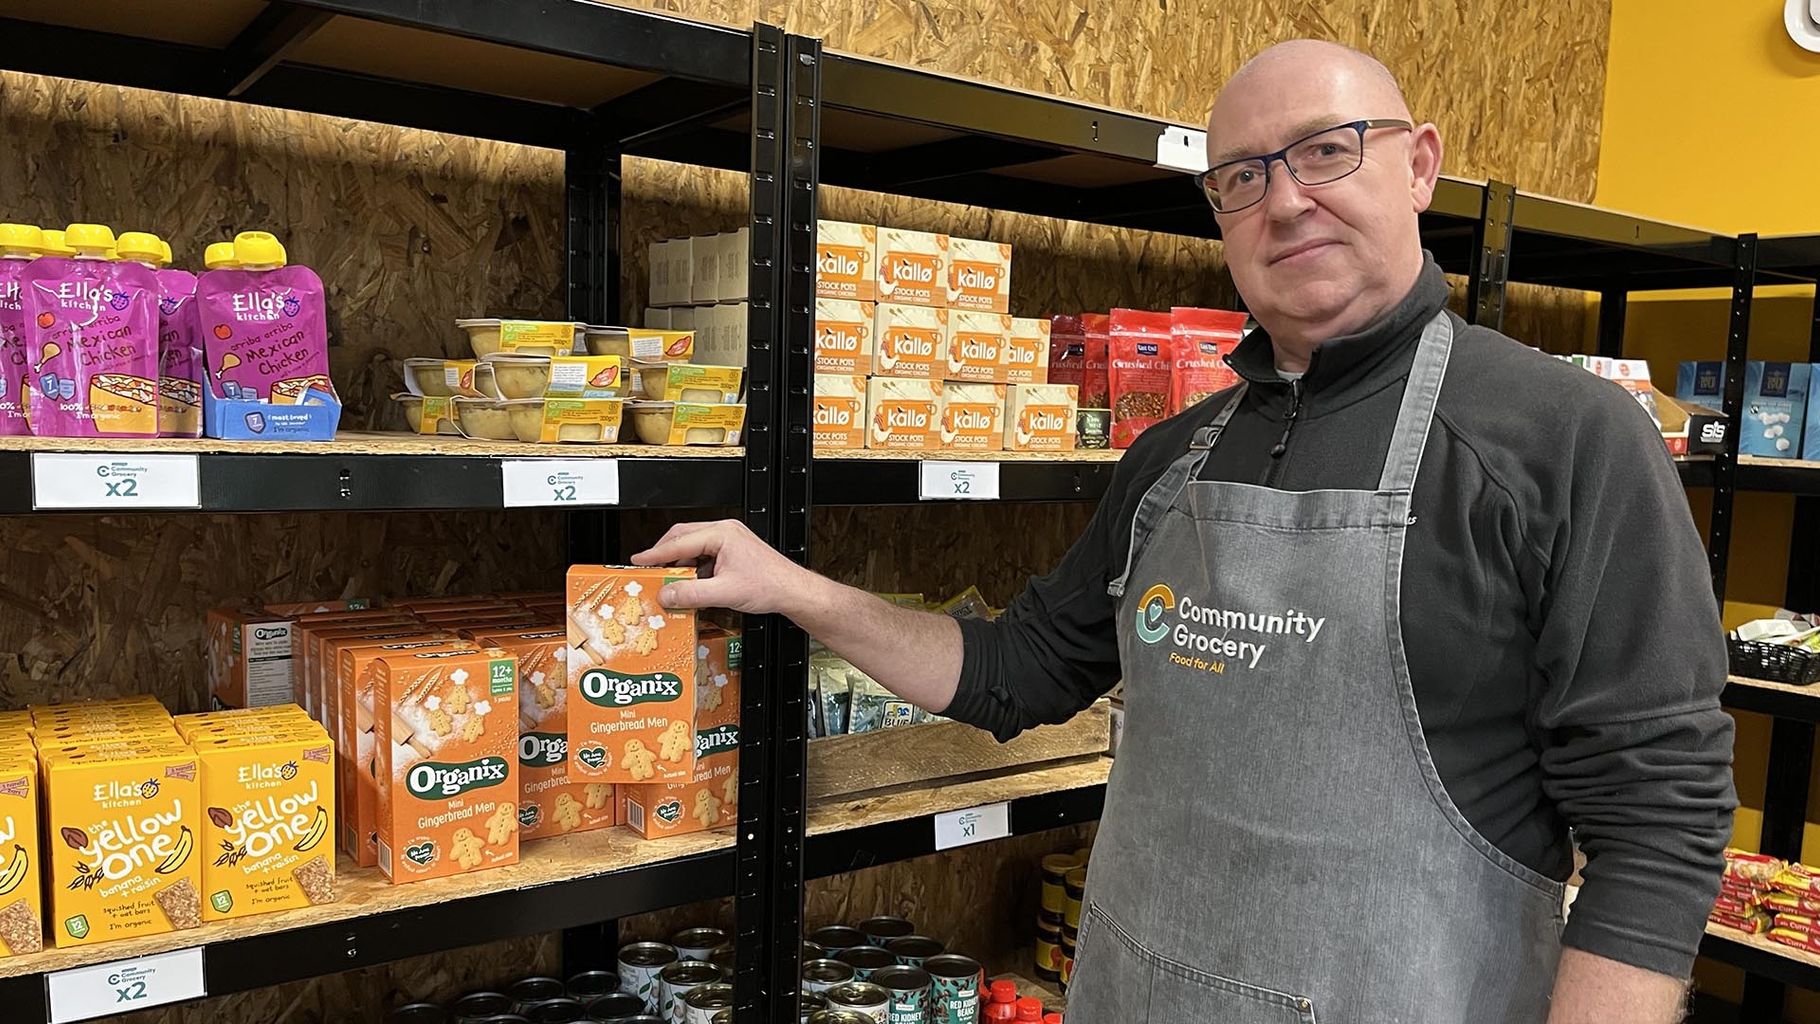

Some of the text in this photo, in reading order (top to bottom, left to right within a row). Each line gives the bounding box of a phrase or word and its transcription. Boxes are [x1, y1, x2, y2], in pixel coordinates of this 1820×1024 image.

[59, 282, 113, 302] Ella's
[817, 281, 856, 291] STOCK POTS
[894, 288, 914, 296] STOCK
[232, 292, 285, 311] Ella's
[979, 296, 992, 304] POTS
[67, 325, 132, 351] Mexican
[231, 323, 294, 351] arriba arriba
[80, 344, 136, 366] Chicken
[246, 331, 304, 363] Mexican
[1008, 347, 1034, 363] allø
[258, 348, 309, 375] Chicken
[817, 357, 855, 367] STOCK POTS
[895, 362, 930, 371] STOCK POTS
[1051, 359, 1083, 369] rushed
[1112, 358, 1152, 369] Crushed
[1176, 357, 1215, 369] Crushed
[980, 366, 994, 375] POTS
[60, 403, 83, 411] 100%
[814, 432, 847, 440] TOCK POTS
[106, 478, 138, 496] x2
[554, 486, 576, 501] x2
[954, 481, 970, 493] x2
[1179, 597, 1325, 642] Community
[1173, 624, 1265, 669] Grocery
[1169, 652, 1225, 674] Food for All
[492, 665, 512, 678] 12+
[583, 672, 678, 704] Organix
[620, 710, 636, 719] Mini
[590, 717, 668, 735] Gingerbread Men
[519, 735, 568, 762] Orga
[696, 726, 738, 758] ganix
[238, 763, 282, 783] Ella's
[410, 759, 505, 795] Organix
[551, 766, 565, 776] Mini
[714, 765, 731, 777] Men
[94, 781, 142, 800] Ella's
[246, 781, 282, 790] kitchen
[525, 775, 571, 793] Gingerbre
[102, 799, 141, 809] kitchen
[232, 801, 251, 814] the
[448, 799, 464, 809] Mini
[224, 780, 318, 846] yellow
[418, 801, 496, 829] Gingerbread Men
[79, 799, 181, 868] yellow
[88, 820, 108, 834] the
[245, 813, 311, 857] one
[963, 823, 975, 837] x1
[102, 834, 174, 880] one
[242, 853, 282, 874] banana
[271, 854, 299, 870] raisin
[99, 875, 143, 898] banana
[131, 877, 161, 894] raisin
[1790, 922, 1809, 933] Curry
[1786, 939, 1807, 949] Curry
[121, 968, 156, 977] Community
[116, 982, 147, 1002] x2
[950, 1000, 962, 1009] RED
[957, 1006, 974, 1018] BEANS
[900, 1012, 922, 1021] KIDNEY
